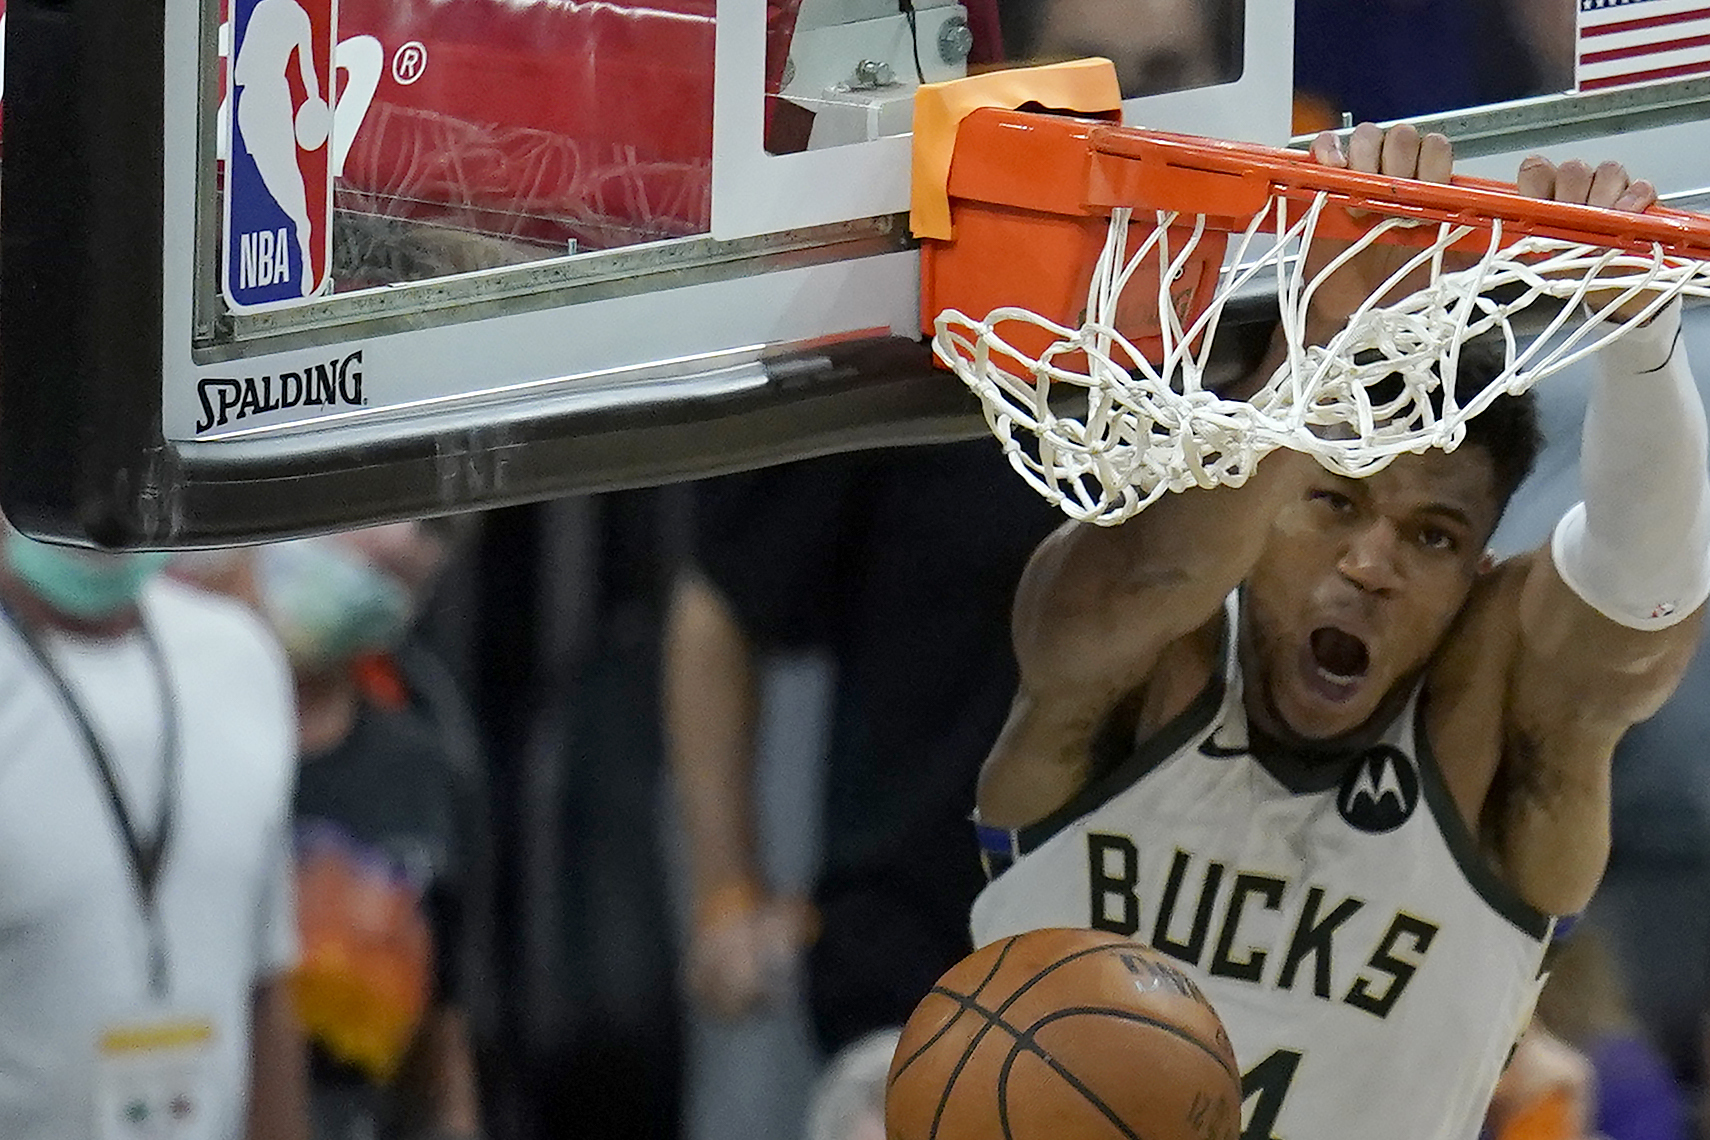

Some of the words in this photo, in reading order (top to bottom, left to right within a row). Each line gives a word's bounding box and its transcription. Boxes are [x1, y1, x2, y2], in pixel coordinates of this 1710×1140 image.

[239, 227, 291, 290] NBA
[195, 349, 364, 435] SPALDING
[1086, 832, 1440, 1019] BUCKS
